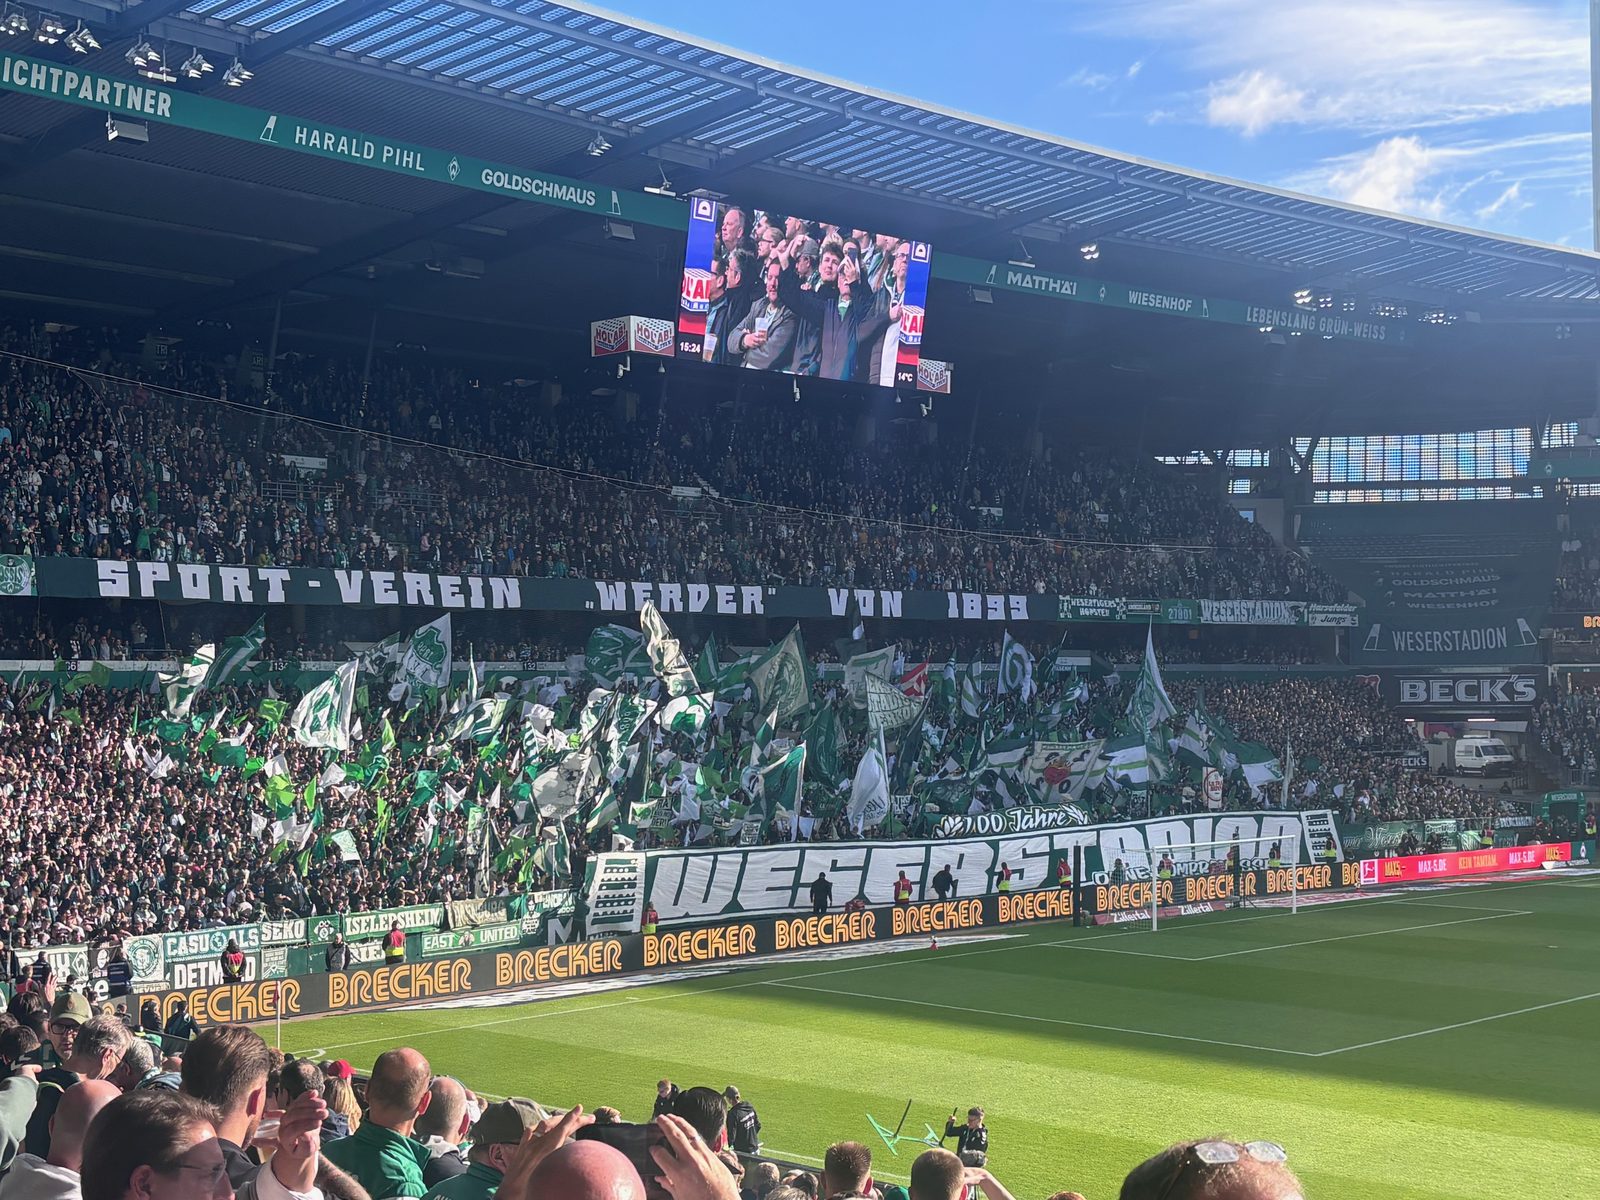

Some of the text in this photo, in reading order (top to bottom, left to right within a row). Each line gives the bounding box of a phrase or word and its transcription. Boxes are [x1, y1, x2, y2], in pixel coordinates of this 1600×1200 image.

[3, 57, 171, 118] ICHTPARTNER
[294, 126, 425, 171] HARALD PIHL
[481, 168, 596, 206] GOLDSCHMAUS
[1007, 271, 1077, 295] MATTHÄI
[1128, 290, 1192, 312] WIESENHOF
[1246, 306, 1386, 340] LEBENSLANG GRÜN-WEISS
[680, 341, 701, 353] 15:24
[1391, 575, 1501, 586] GOLDSCHMAUS
[827, 588, 903, 618] VON
[947, 591, 1029, 620] 1899
[1201, 600, 1290, 622] WESERSTADION
[1407, 599, 1499, 609] WIESENHOF
[1321, 615, 1347, 625] Jungs
[1391, 626, 1508, 652] WESERSTADION
[523, 662, 536, 671] 132
[1400, 674, 1537, 703] BECK'S
[1009, 808, 1067, 832] Jahre
[650, 816, 1301, 918] WESERSTADION
[1266, 865, 1332, 894] BRECKER
[1418, 859, 1447, 874] MAX-5.DE
[1096, 880, 1174, 912] BRECKER
[1186, 872, 1256, 902] BRECKR
[892, 898, 983, 936] BRECKER
[1113, 909, 1151, 924] Zillertal
[1178, 902, 1213, 917] Zillertal
[261, 919, 306, 942] SEKO
[424, 934, 454, 950] EAST
[479, 925, 519, 943] UNITED
[775, 910, 876, 950] BRECKER
[643, 924, 756, 967] BRECKER
[174, 956, 256, 990] DETMD
[496, 940, 622, 986] BRECKER
[329, 958, 472, 1008] BRECKER
